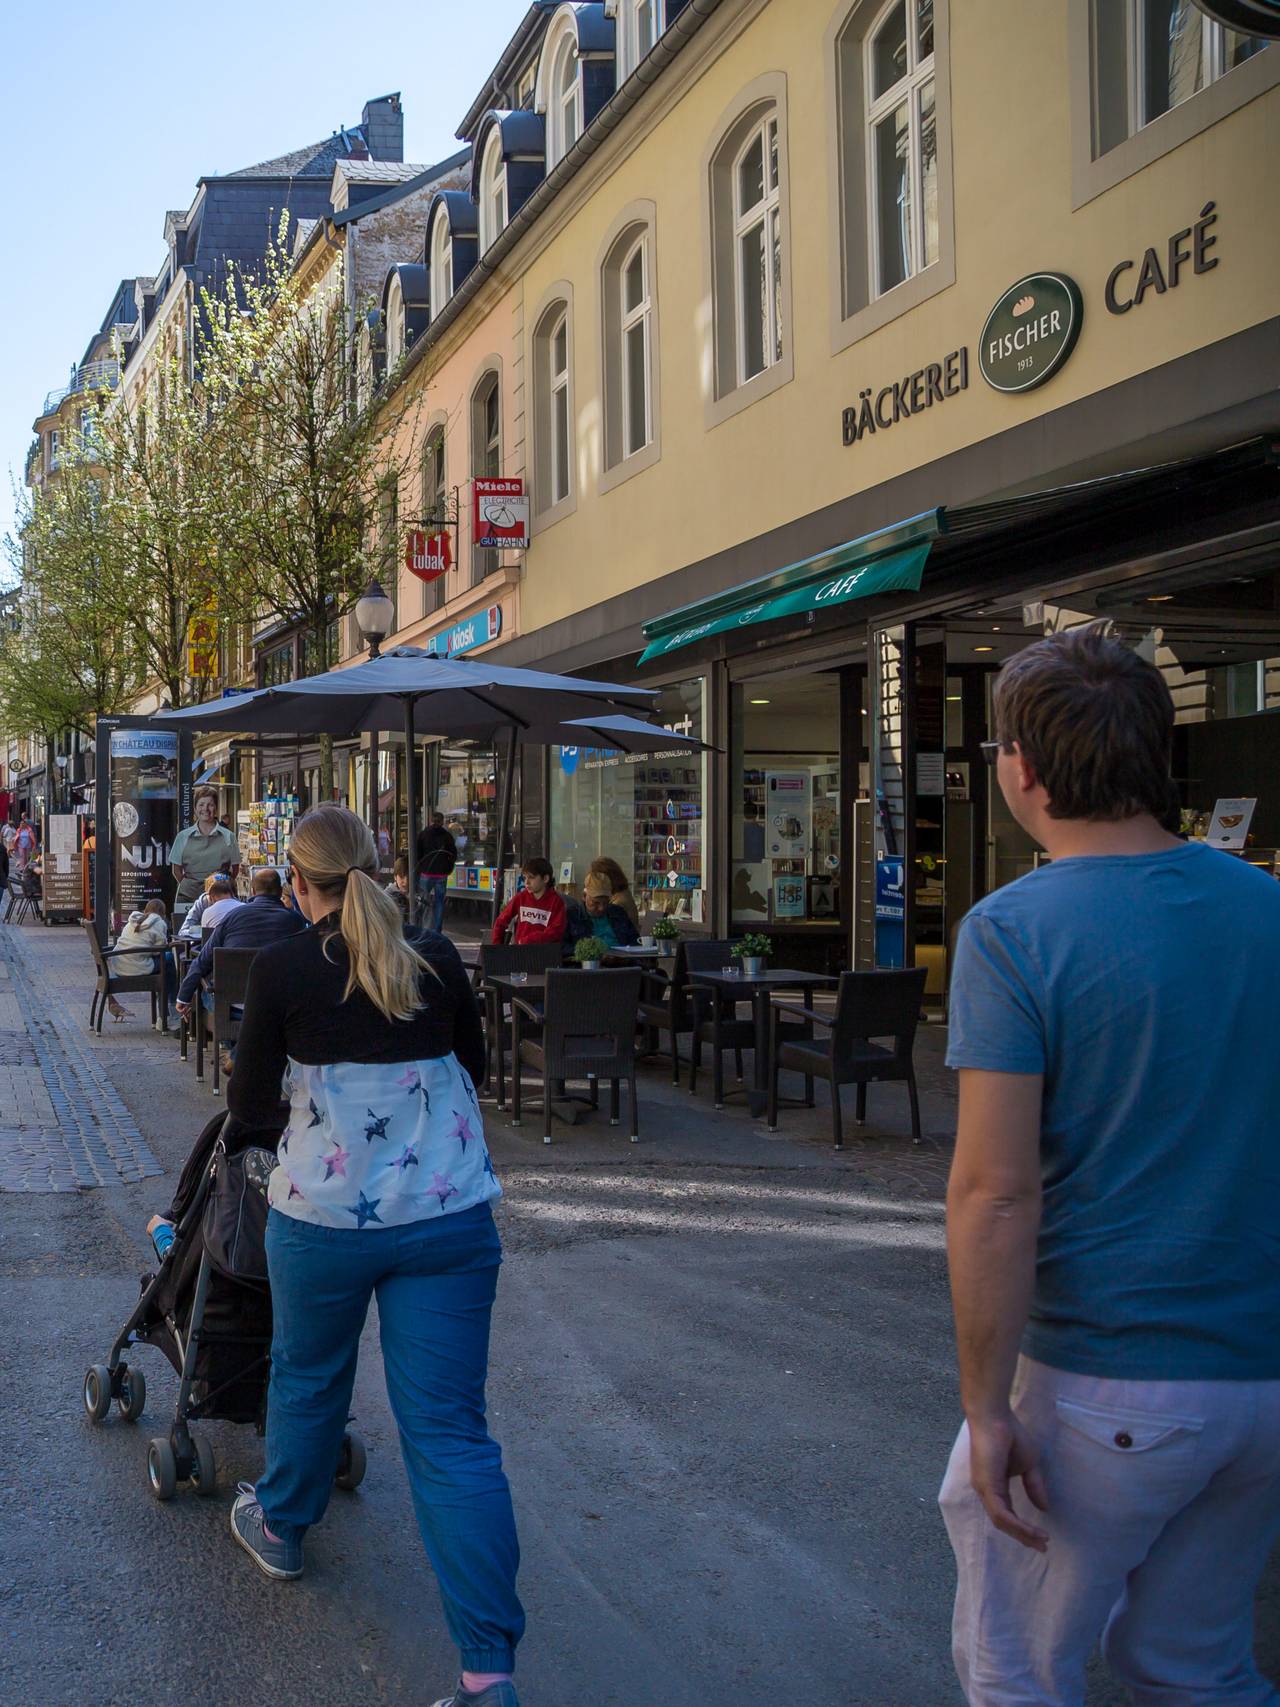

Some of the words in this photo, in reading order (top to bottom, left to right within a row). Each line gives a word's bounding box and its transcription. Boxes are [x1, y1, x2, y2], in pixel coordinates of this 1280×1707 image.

[842, 346, 968, 446] BÄCKEREI
[1104, 201, 1219, 315] CAFÉ
[988, 310, 1061, 363] FISCHER
[1017, 356, 1033, 371] 1913
[476, 482, 520, 491] Miele
[815, 568, 868, 601] CAFÉ
[182, 783, 190, 816] culturel
[778, 894, 802, 904] HOP
